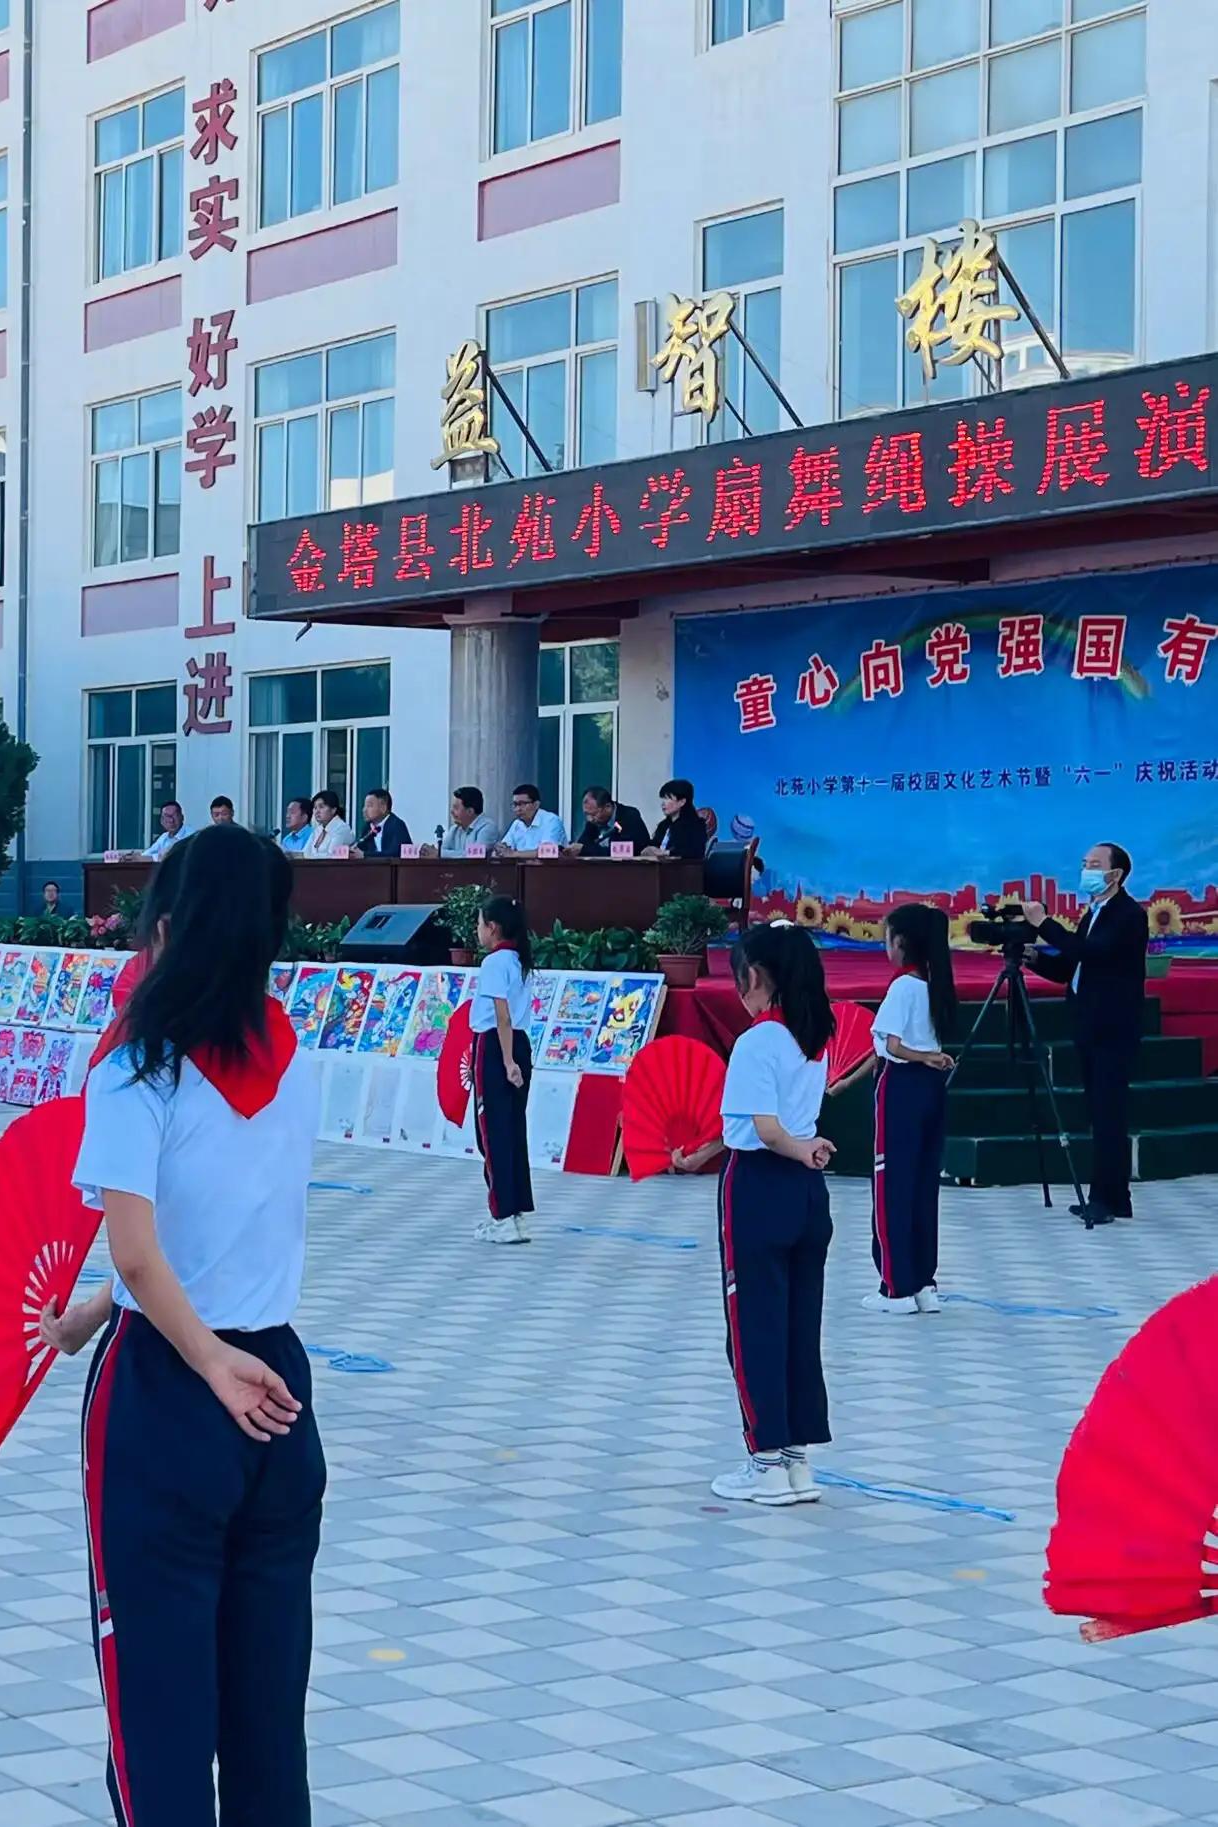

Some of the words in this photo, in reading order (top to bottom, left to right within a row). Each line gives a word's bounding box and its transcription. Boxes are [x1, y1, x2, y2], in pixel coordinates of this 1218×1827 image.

[188, 77, 239, 261] 求实
[184, 310, 238, 489] 好学
[431, 218, 1021, 470] 益智楼
[286, 382, 1212, 593] 金塔县北苑小学扇舞绳操展演
[184, 555, 237, 737] 上进
